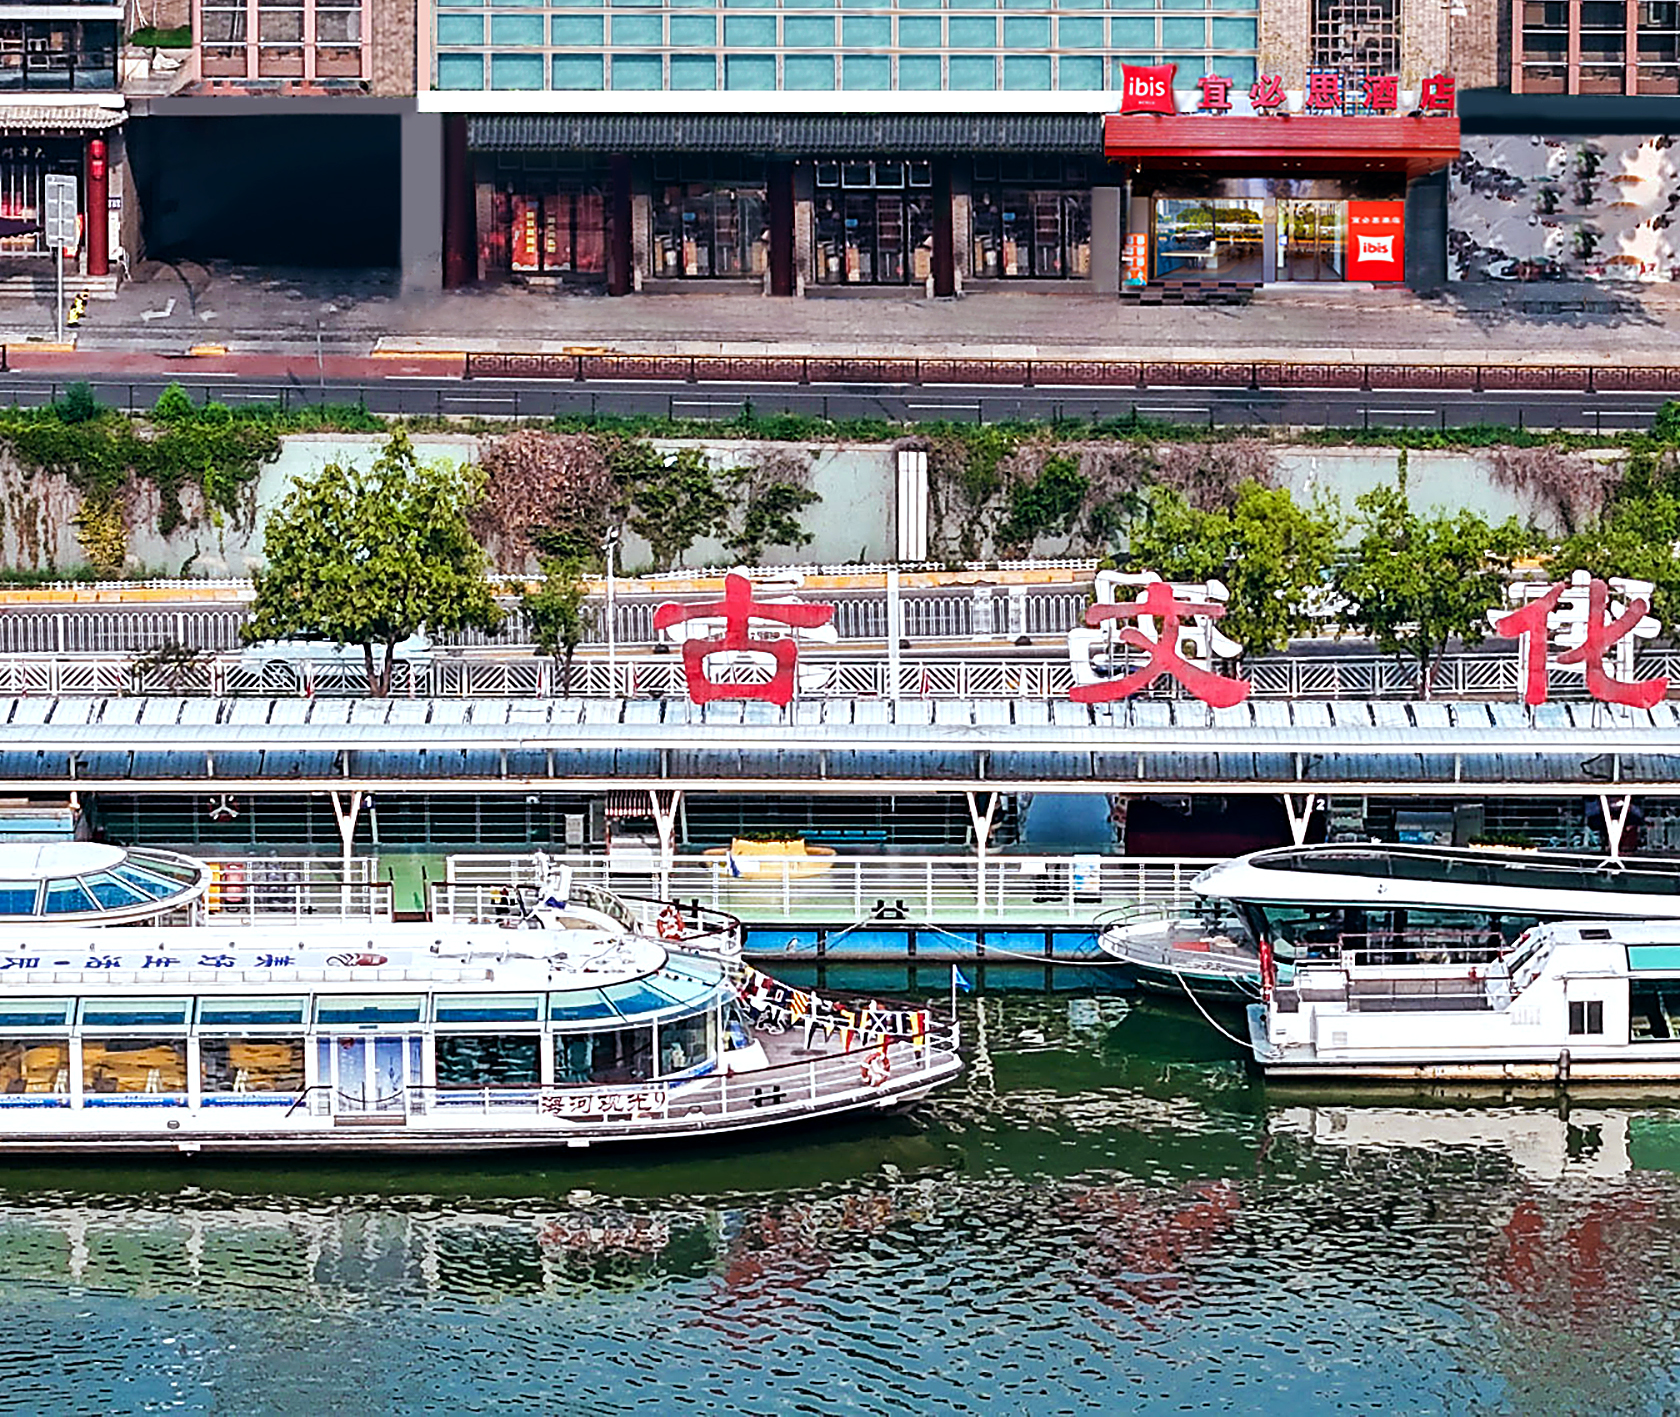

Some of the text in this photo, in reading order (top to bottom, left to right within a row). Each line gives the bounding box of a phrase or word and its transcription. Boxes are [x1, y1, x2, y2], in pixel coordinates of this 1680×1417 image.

[1128, 76, 1166, 98] ibis
[1196, 72, 1456, 110] 宜必思酒店
[1363, 242, 1389, 254] ibis
[1316, 798, 1325, 811] 2
